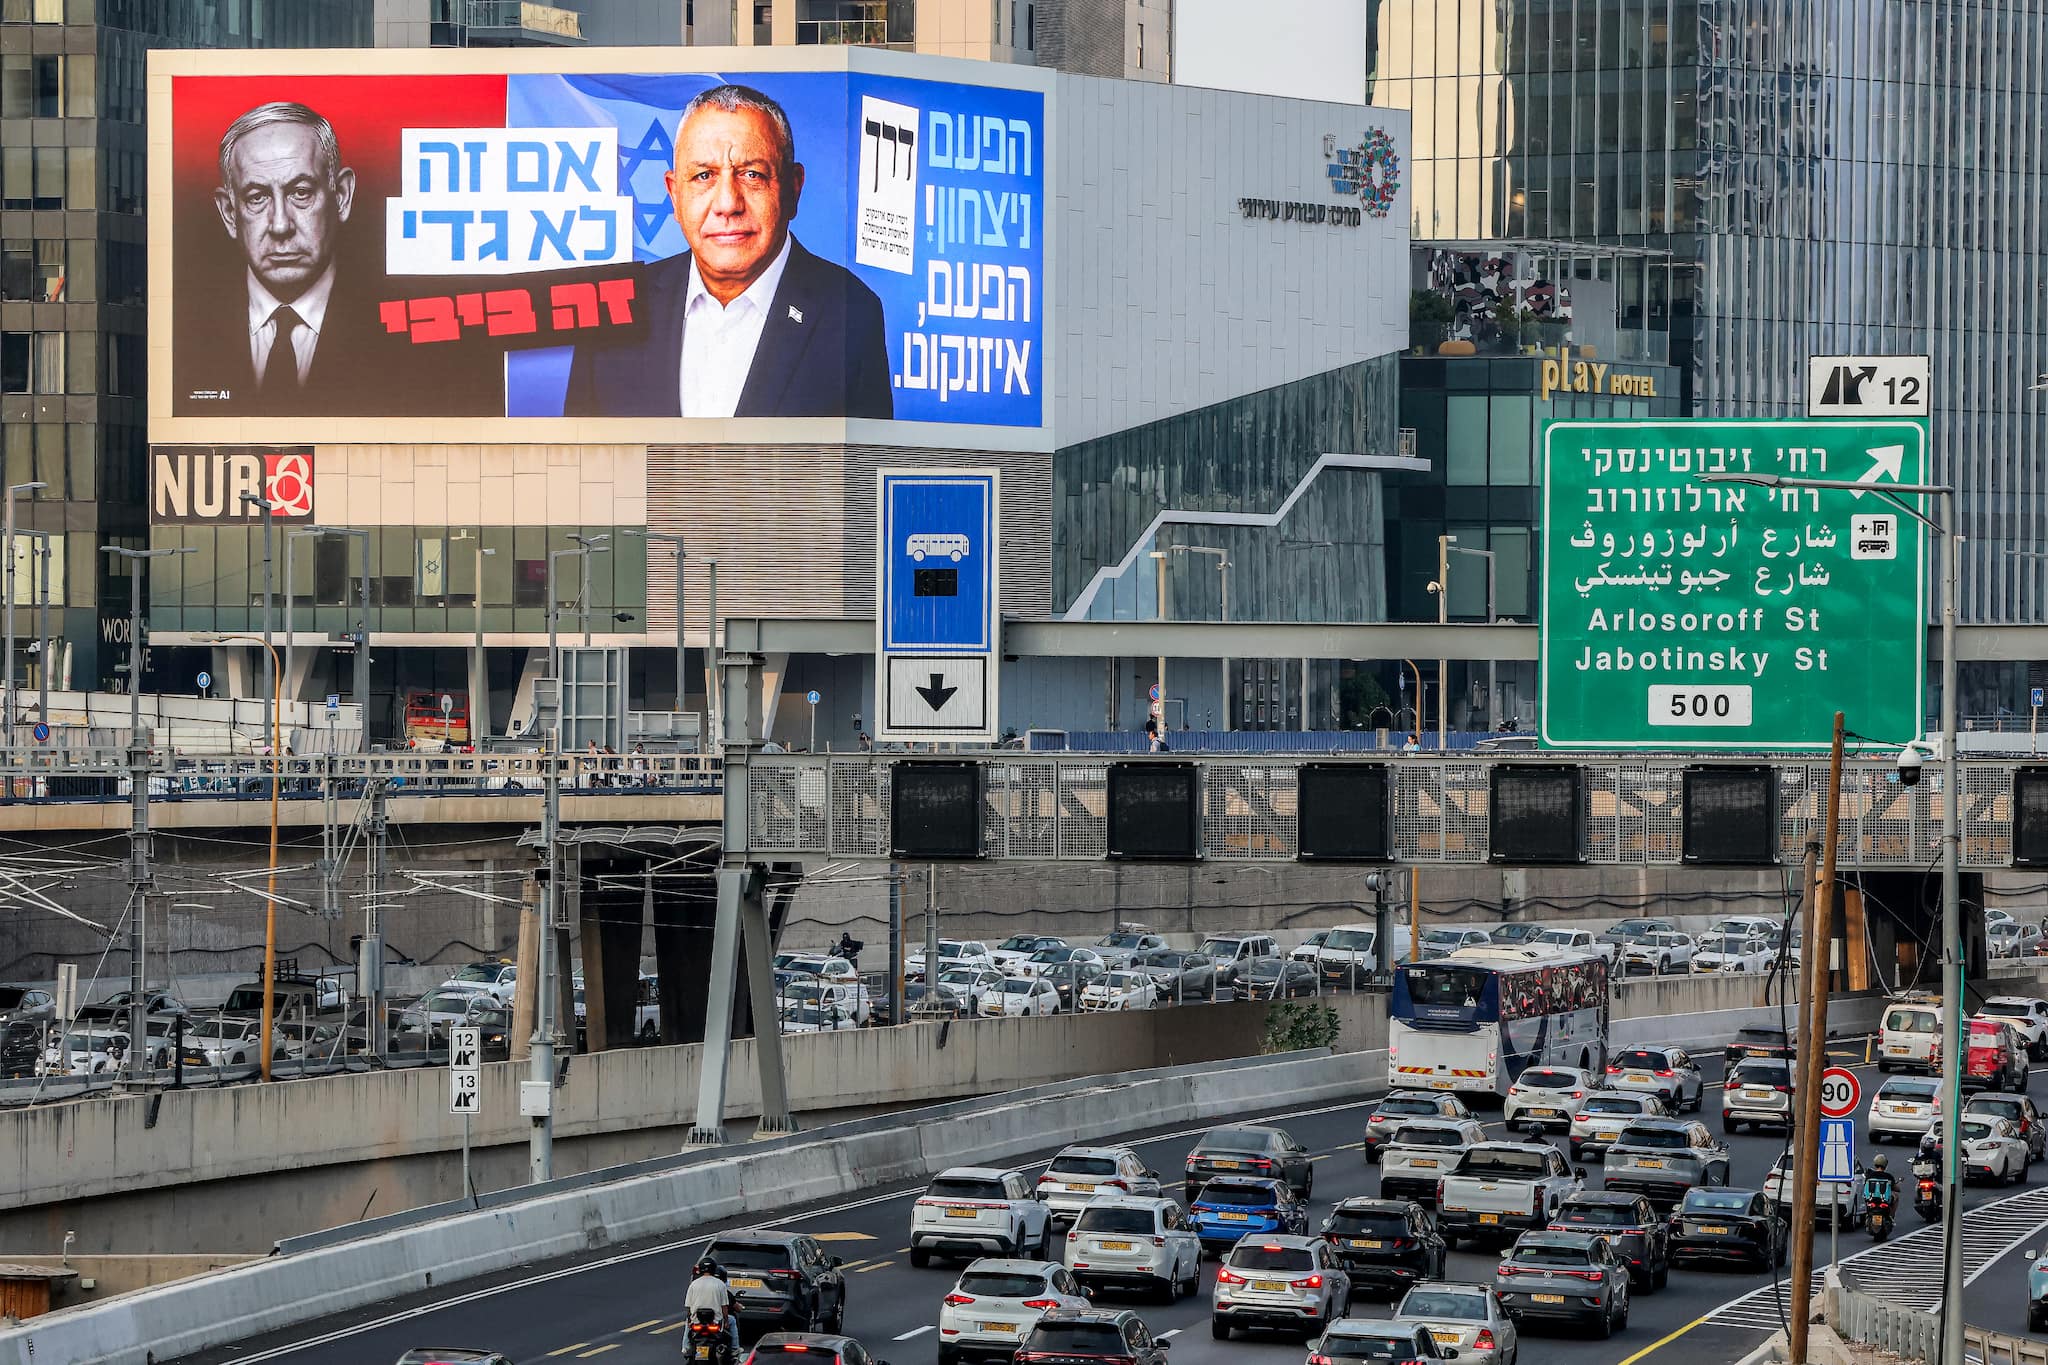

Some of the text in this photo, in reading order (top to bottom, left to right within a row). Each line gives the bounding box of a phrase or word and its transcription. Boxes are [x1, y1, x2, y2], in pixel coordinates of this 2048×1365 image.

[929, 110, 1032, 177] הפעם
[418, 141, 601, 193] אם זה
[402, 204, 617, 261] לא גדי
[925, 184, 1031, 254] ניצחון!
[918, 259, 1031, 328] הפעם,
[379, 278, 635, 344] זה ביבי
[894, 332, 1031, 402] איזנקוט.
[219, 390, 230, 399] AI
[1610, 374, 1657, 397] HOTEL
[1883, 376, 1921, 405] 12
[155, 454, 261, 517] NUR
[1587, 483, 1746, 513] ארלוזורוב
[1760, 524, 1837, 558] شارع
[1574, 561, 1831, 598] شارع جبوتينسكي
[1587, 606, 1820, 632] Arlosoroff St
[1575, 646, 1828, 677] Jabotinsky St
[1670, 694, 1731, 718] 500
[456, 1033, 474, 1047] 12
[458, 1075, 475, 1088] 13
[1822, 1082, 1850, 1102] 90
